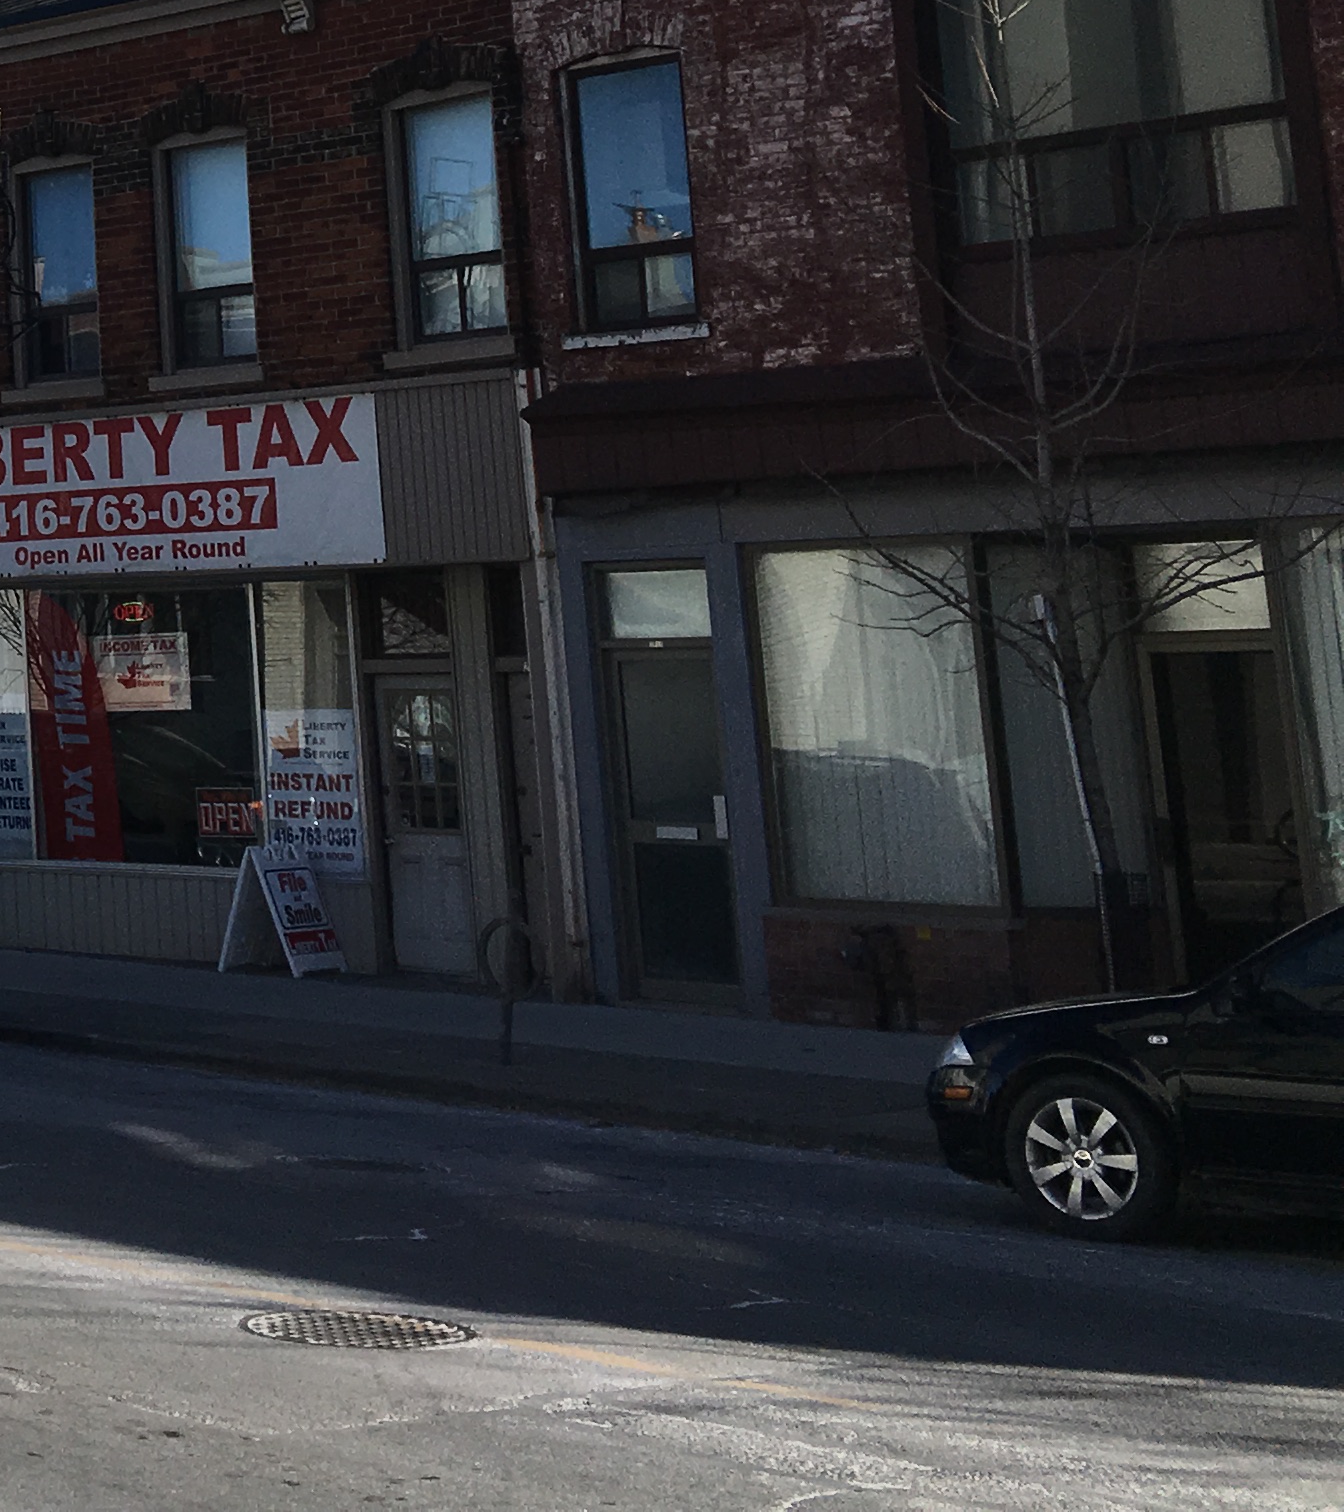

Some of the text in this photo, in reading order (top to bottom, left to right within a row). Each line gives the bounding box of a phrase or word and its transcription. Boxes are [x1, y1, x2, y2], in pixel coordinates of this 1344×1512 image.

[207, 397, 359, 472] TAX
[14, 537, 246, 569] Open All Year Round
[113, 603, 154, 620] OPEN
[154, 638, 178, 651] TAX
[52, 650, 90, 749] TIME
[302, 720, 346, 731] LIBERTY
[303, 734, 326, 746] TAX
[303, 748, 350, 760] SERVICE
[270, 772, 353, 793] INSTANT
[62, 765, 96, 841] TAX
[274, 800, 354, 821] REFUND
[199, 802, 255, 834] OPEN
[274, 826, 357, 848] 416-763-0387
[277, 872, 307, 893] File
[284, 903, 322, 925] Smile
